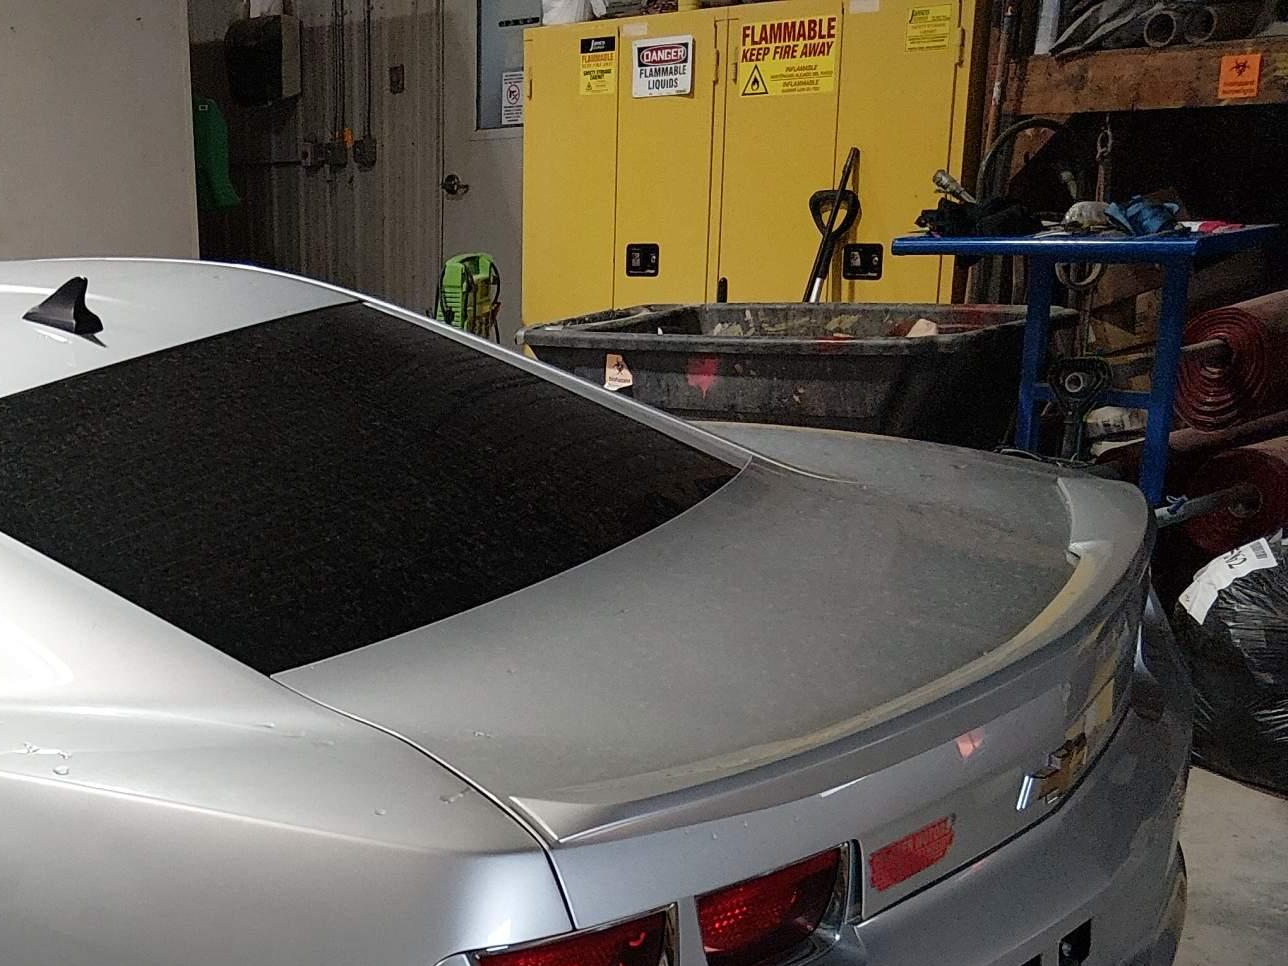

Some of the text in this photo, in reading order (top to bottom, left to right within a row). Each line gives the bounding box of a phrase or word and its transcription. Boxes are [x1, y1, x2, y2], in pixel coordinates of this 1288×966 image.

[742, 17, 836, 46] FLAMMABLE
[643, 48, 684, 62] DANGER
[741, 41, 833, 63] KEEP FIRE AWAY
[639, 65, 687, 79] FLAMMABLE
[648, 78, 679, 90] LIQUIDS
